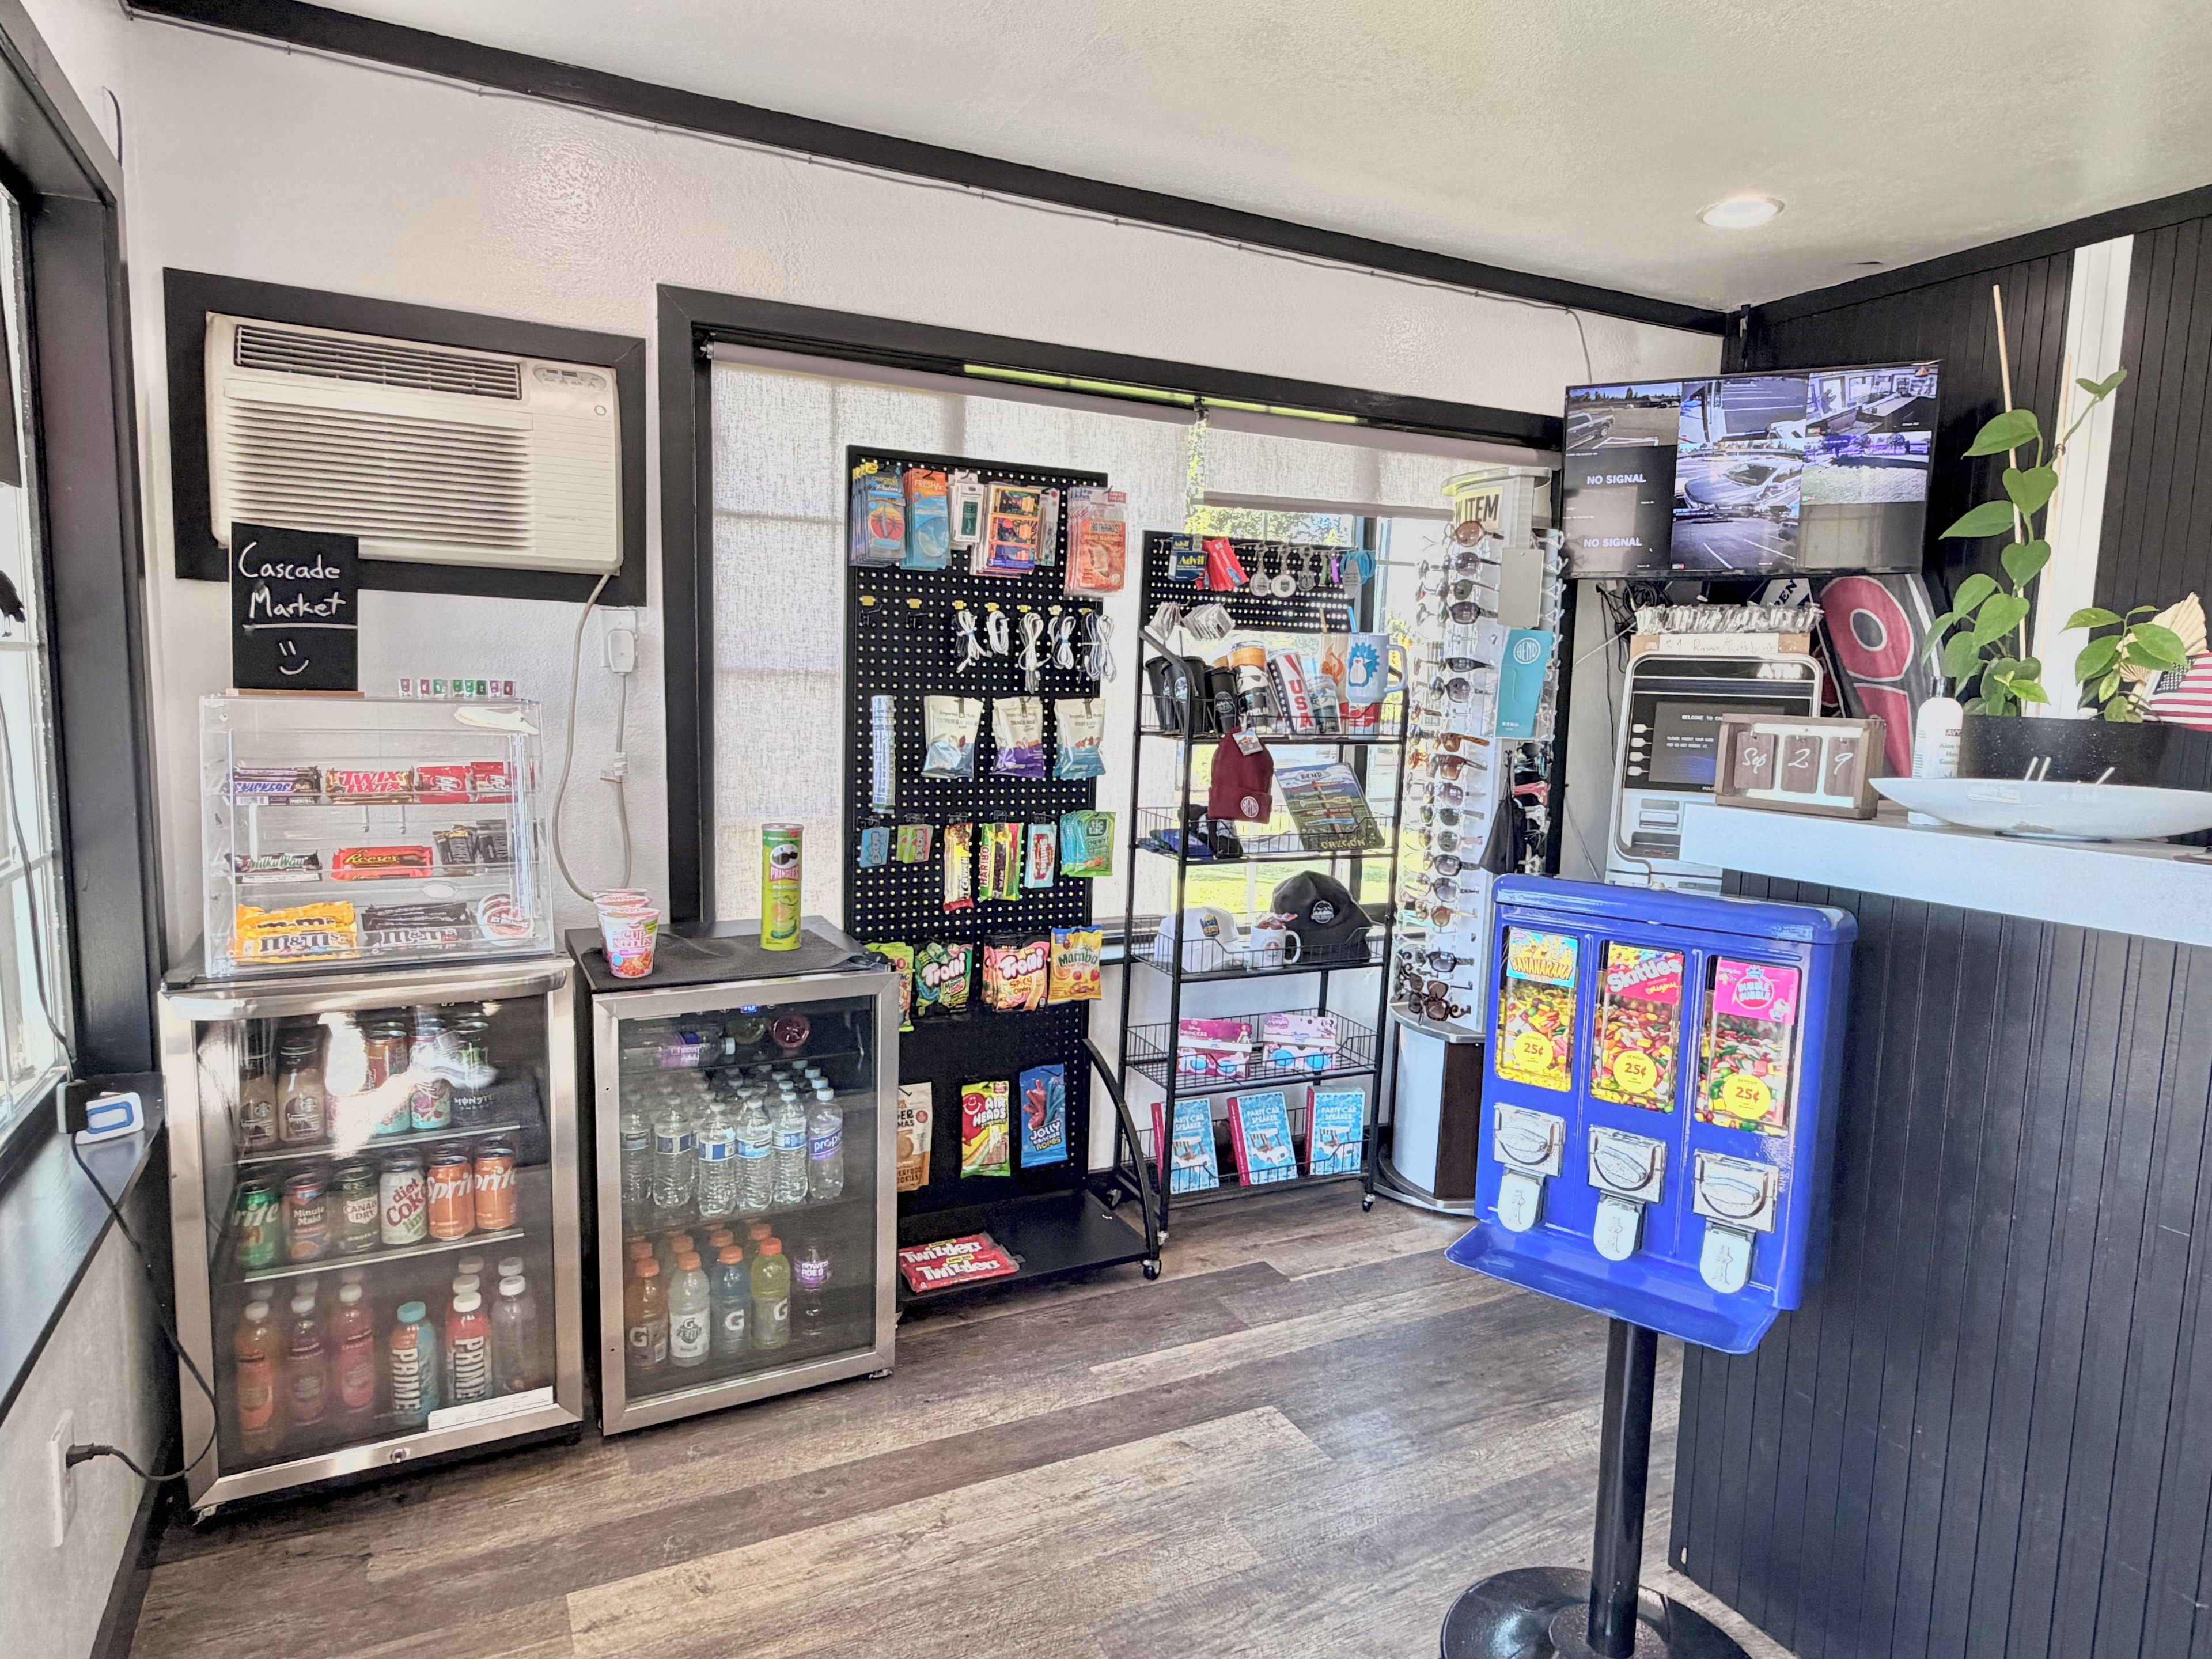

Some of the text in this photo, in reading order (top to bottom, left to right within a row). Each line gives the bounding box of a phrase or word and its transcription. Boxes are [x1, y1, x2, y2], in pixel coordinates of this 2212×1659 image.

[1587, 474, 1646, 484] NO SIGNAL
[1465, 494, 1499, 523] ITEM
[1584, 537, 1642, 547] NO SIGNAL
[238, 541, 340, 579] Cascade
[1179, 555, 1205, 565] Advil
[249, 588, 346, 619] Market
[1517, 641, 1538, 661] BEND
[1757, 663, 1802, 679] ATM
[1288, 679, 1315, 728] USA
[1743, 747, 1767, 774] Sep
[1788, 748, 1810, 768] 2
[1834, 752, 1854, 775] 9
[1091, 820, 1104, 828] tic
[1320, 839, 1366, 849] OREGON
[770, 866, 799, 880] PRINGLES
[980, 846, 990, 887] HARIBO
[613, 937, 652, 948] NOODLES
[622, 930, 646, 940] CUP
[922, 952, 965, 987] Trolli
[999, 948, 1044, 979] Trolli
[1058, 951, 1099, 968] Mamba
[1511, 956, 1574, 980] BANANARAMA
[1607, 959, 1683, 993] Skittles
[1739, 982, 1771, 992] DUBBLE
[1739, 991, 1771, 1001] BUBBLE
[1524, 1043, 1543, 1058] 25¢
[1625, 1062, 1647, 1078] 25¢
[986, 1096, 1006, 1110] AIR
[1736, 1086, 1760, 1106] 25¢
[973, 1107, 1006, 1127] HEADS
[1175, 1113, 1205, 1123] ARTY CAR
[1247, 1106, 1280, 1117] PARTY CAR
[1251, 1115, 1278, 1124] SPEAKER
[1321, 1106, 1340, 1115] PARTY
[1030, 1121, 1060, 1141] JOLLY
[1036, 1138, 1061, 1150] ROPES
[393, 1177, 419, 1203] diet
[294, 1206, 324, 1218] Minute
[386, 1183, 428, 1226] Coke
[297, 1214, 322, 1225] Maid
[355, 1209, 375, 1221] DRY
[899, 1241, 982, 1263] Twizzlers
[916, 1259, 1000, 1281] Twizzlers
[774, 1297, 788, 1321] G
[725, 1309, 744, 1331] G
[628, 1326, 649, 1347] G
[393, 1347, 421, 1411] PRIME
